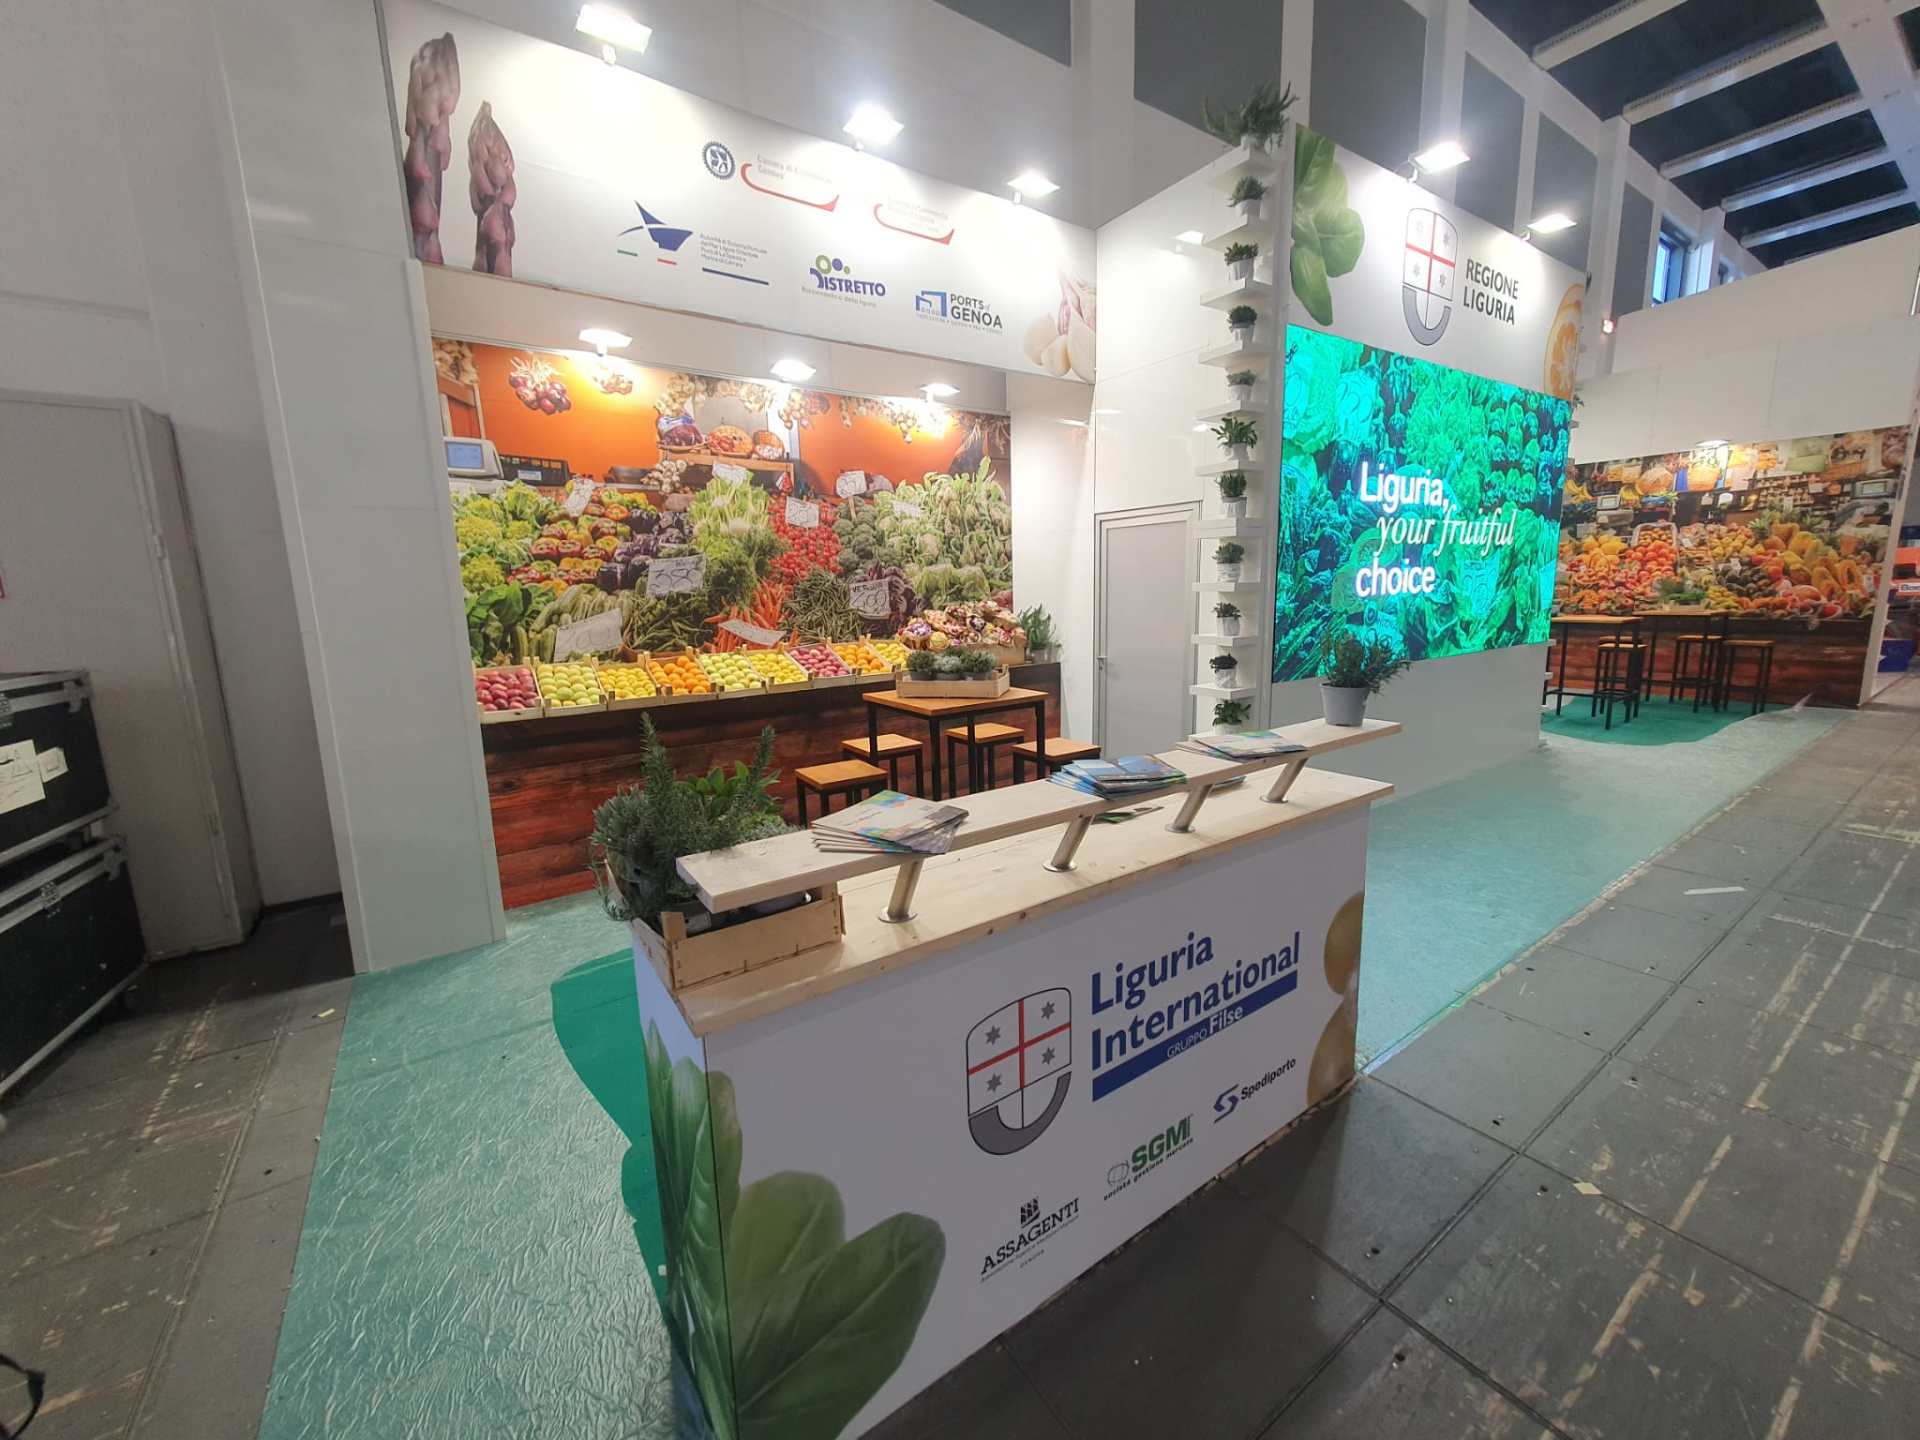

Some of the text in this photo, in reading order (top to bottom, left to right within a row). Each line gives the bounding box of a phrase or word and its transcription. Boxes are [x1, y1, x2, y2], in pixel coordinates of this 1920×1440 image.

[950, 293, 984, 310] PORTS
[1465, 258, 1519, 300] REGIONE
[951, 306, 1003, 329] GENOA
[1463, 287, 1516, 326] LIGURIA
[1360, 461, 1450, 515] Liguria,
[1376, 504, 1517, 558] your fruitful
[1355, 557, 1437, 597] choice
[1091, 932, 1214, 1016] Liguria
[1091, 930, 1300, 1071] International
[1166, 1006, 1244, 1058] GRUPPO Filse
[1241, 1058, 1296, 1100] Spediporto
[980, 1197, 1080, 1276] ASSAGENTI
